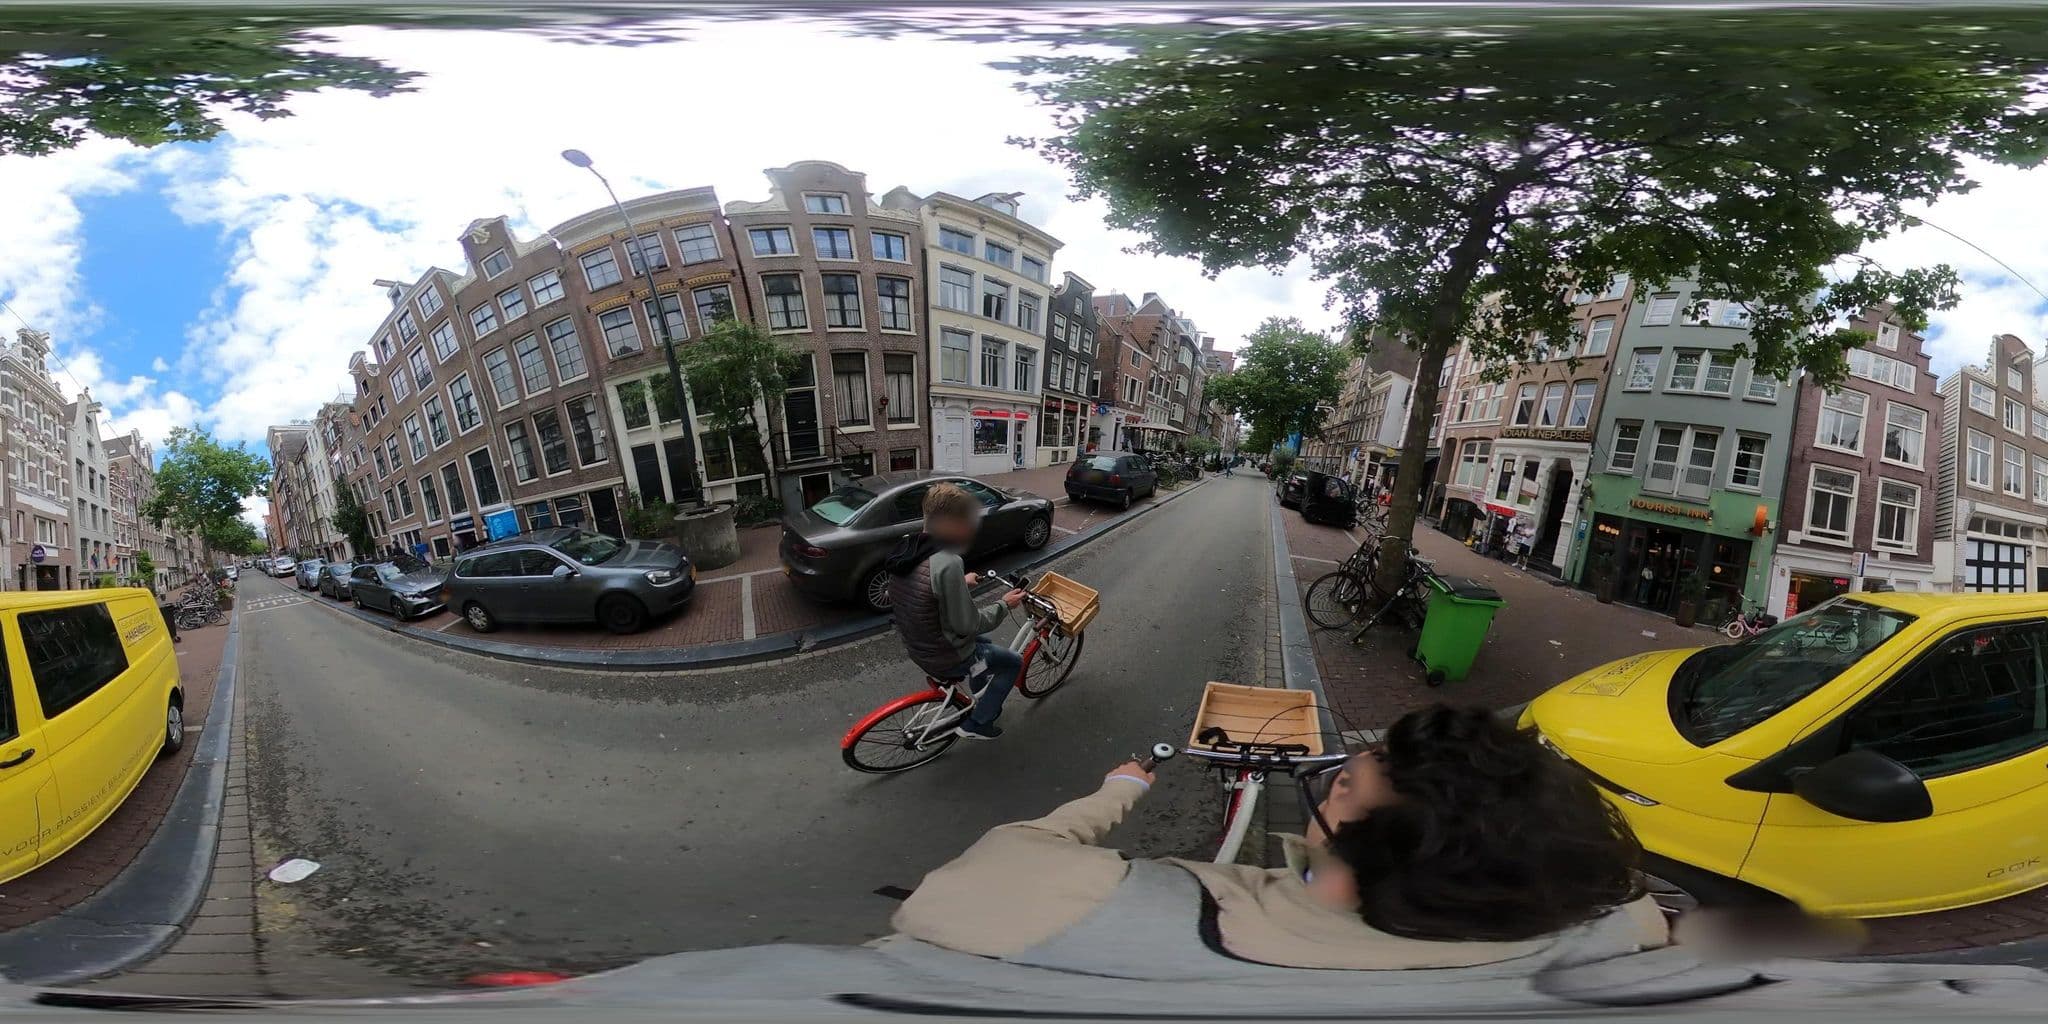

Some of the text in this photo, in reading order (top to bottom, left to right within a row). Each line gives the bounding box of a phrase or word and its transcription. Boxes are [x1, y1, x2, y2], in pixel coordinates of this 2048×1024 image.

[1537, 429, 1592, 441] NEPALESE
[1631, 499, 1710, 520] TOURIST INN
